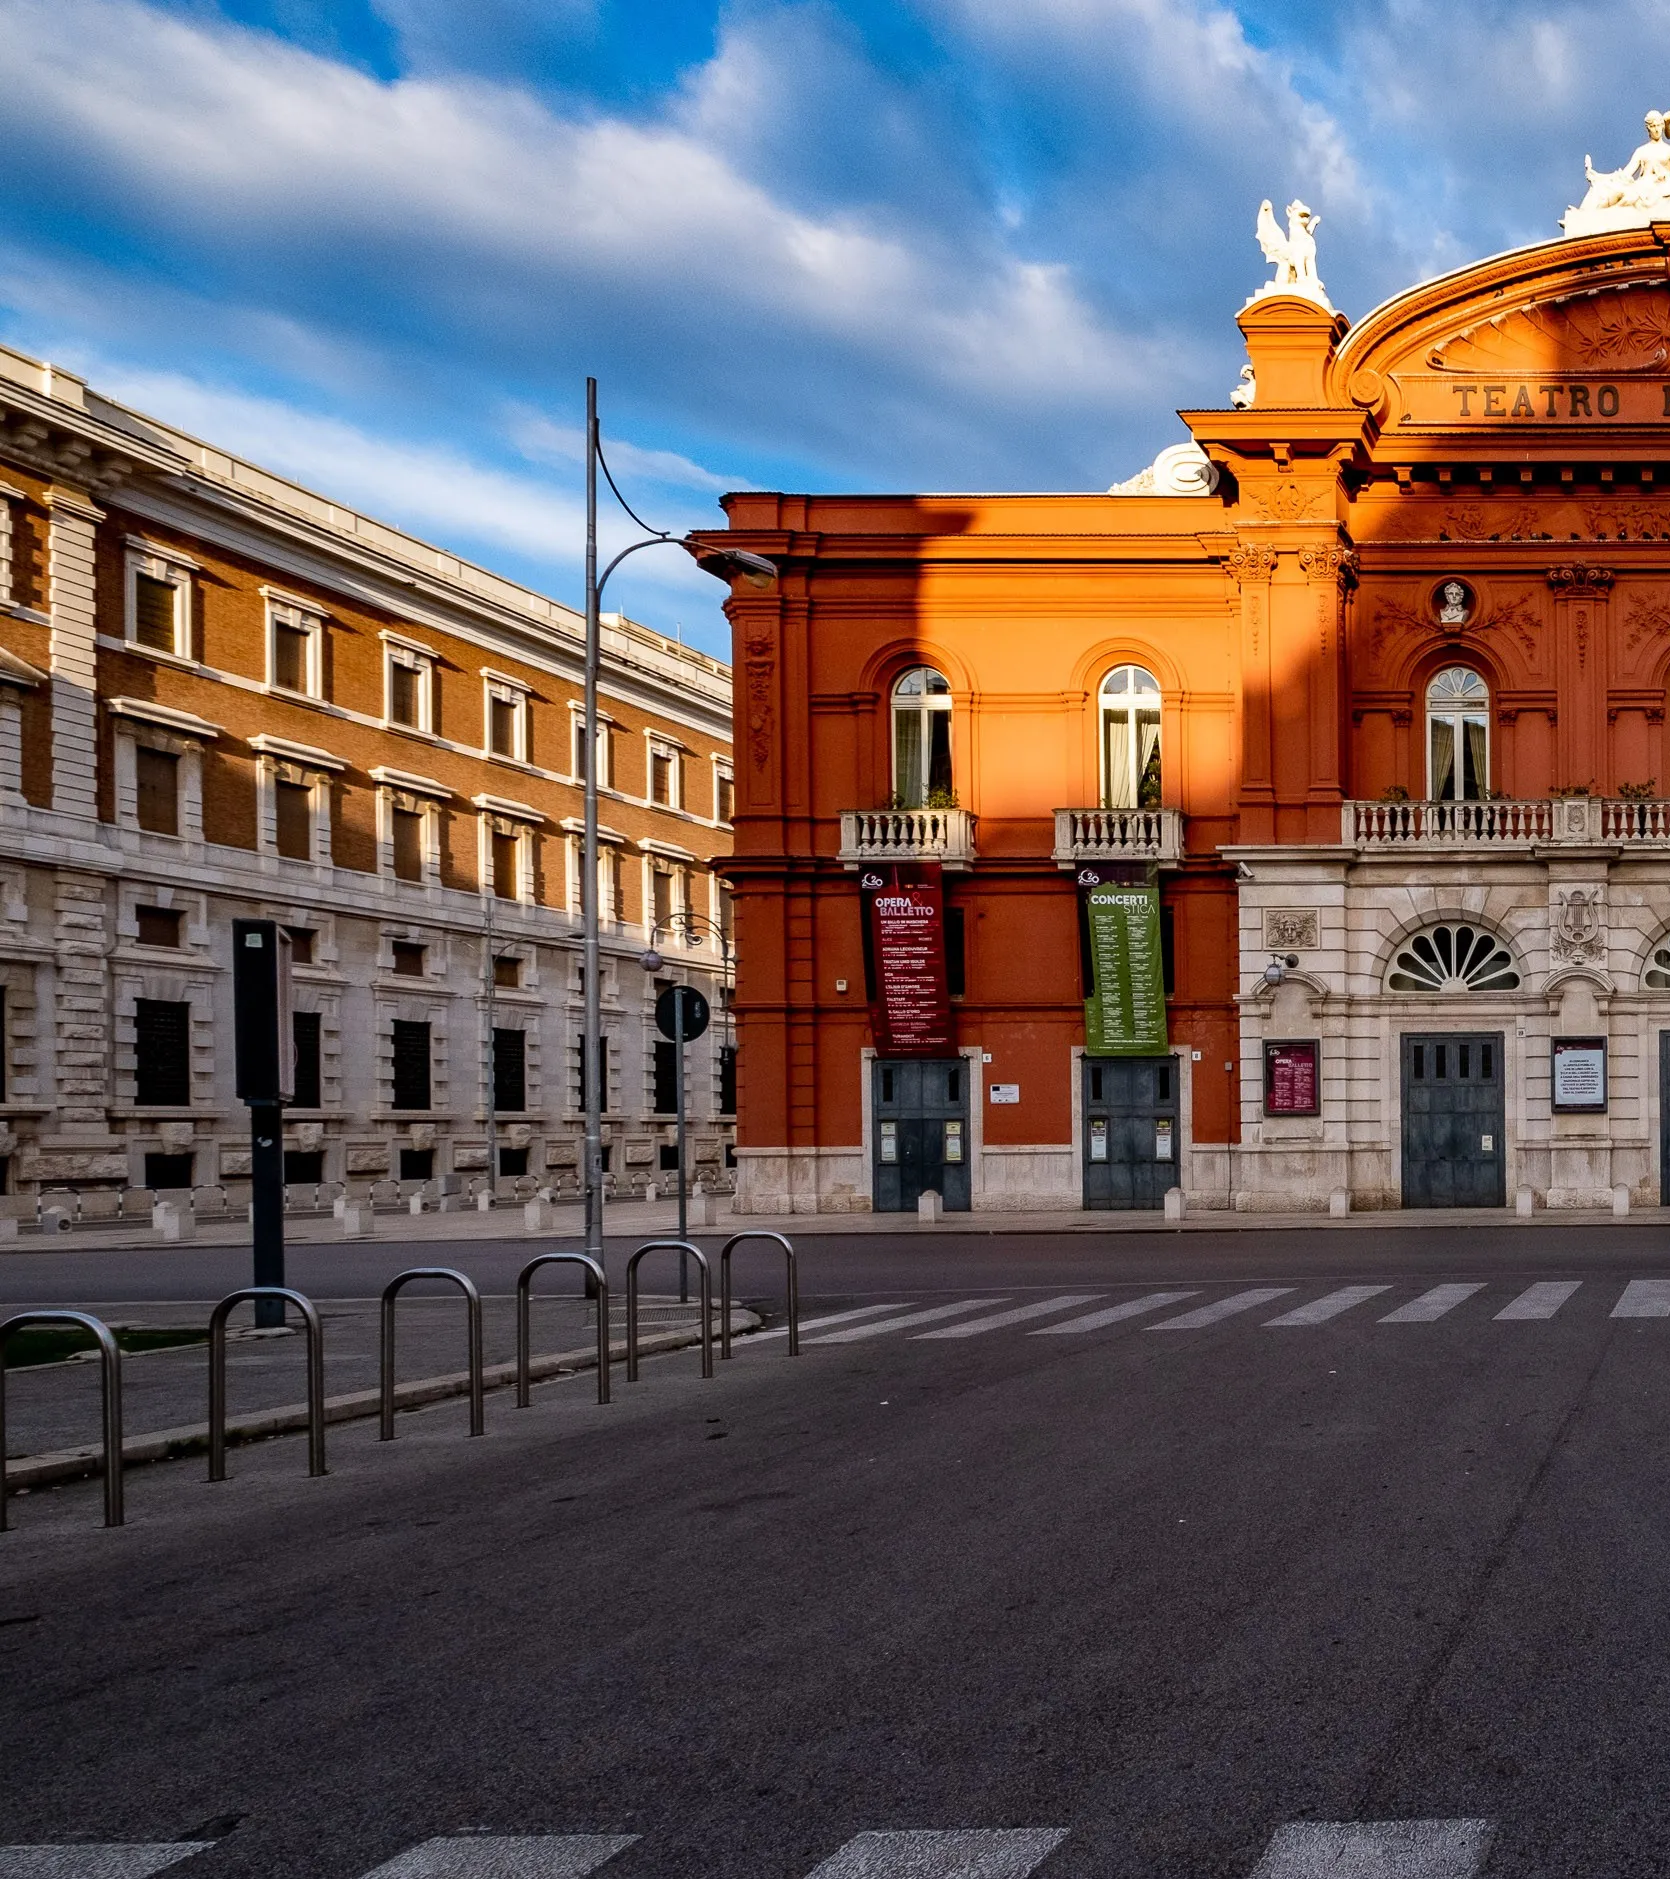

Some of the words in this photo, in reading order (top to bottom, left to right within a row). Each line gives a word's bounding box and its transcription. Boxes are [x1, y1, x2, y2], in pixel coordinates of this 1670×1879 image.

[1452, 385, 1620, 417] TEATRO
[875, 898, 911, 907] OPERA
[880, 907, 934, 916] BALLETTO
[1124, 905, 1155, 914] STICA
